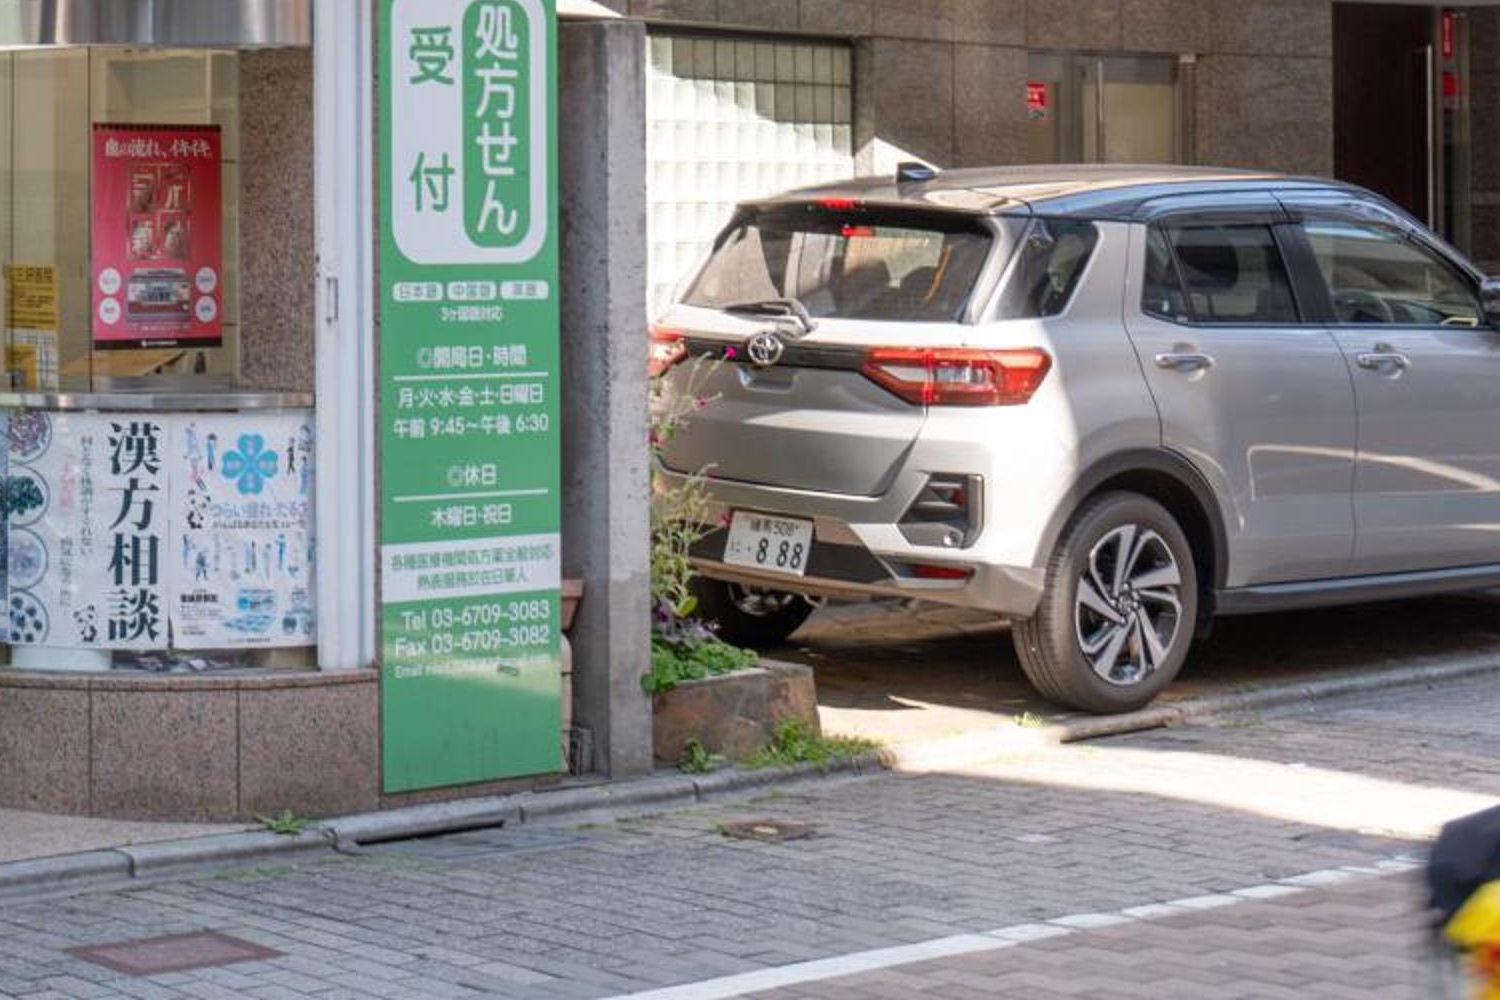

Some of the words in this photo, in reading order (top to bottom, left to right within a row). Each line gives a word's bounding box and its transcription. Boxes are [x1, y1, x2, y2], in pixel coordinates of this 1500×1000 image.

[410, 26, 455, 213] 受付
[475, 5, 518, 235] 処方せん
[393, 418, 425, 439] 午前
[515, 413, 549, 432] 6:30
[108, 421, 161, 642] 漢方相談
[395, 638, 427, 657] Fax
[432, 625, 549, 654] 03-6709-3082
[400, 610, 427, 631] Tel
[432, 600, 549, 628] 03-6709-3083
